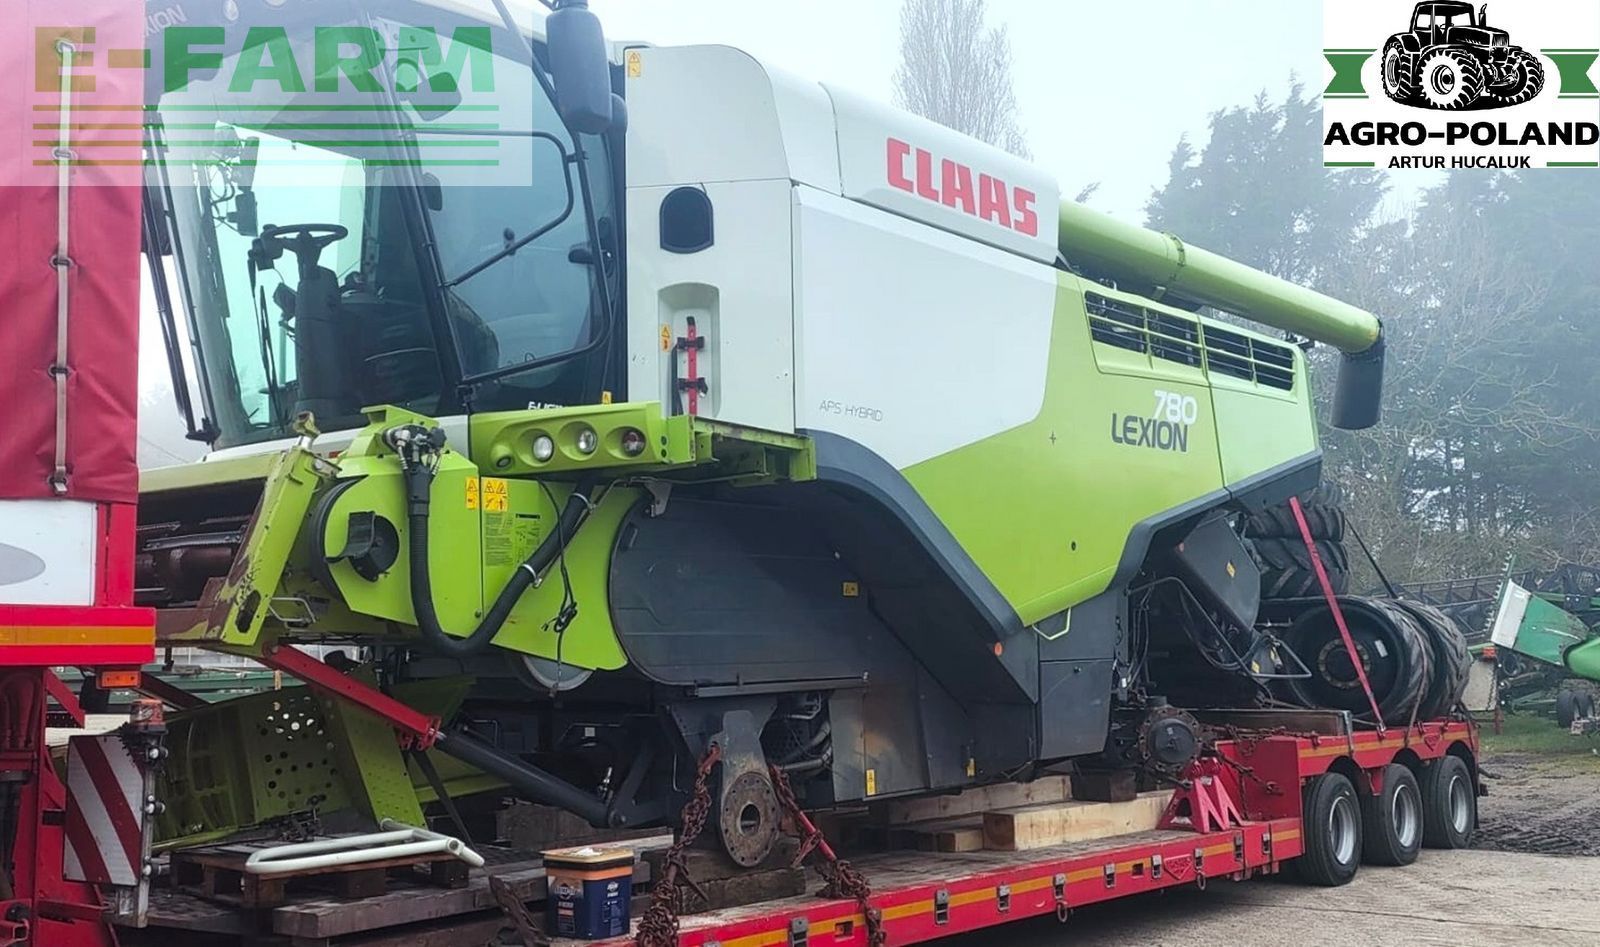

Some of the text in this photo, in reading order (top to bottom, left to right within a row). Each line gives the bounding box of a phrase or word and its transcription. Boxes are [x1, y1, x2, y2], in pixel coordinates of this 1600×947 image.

[887, 137, 1038, 237] CLAAS
[819, 399, 883, 422] APS HYBRID
[1154, 389, 1198, 425] 780
[1111, 412, 1188, 453] LEXION
